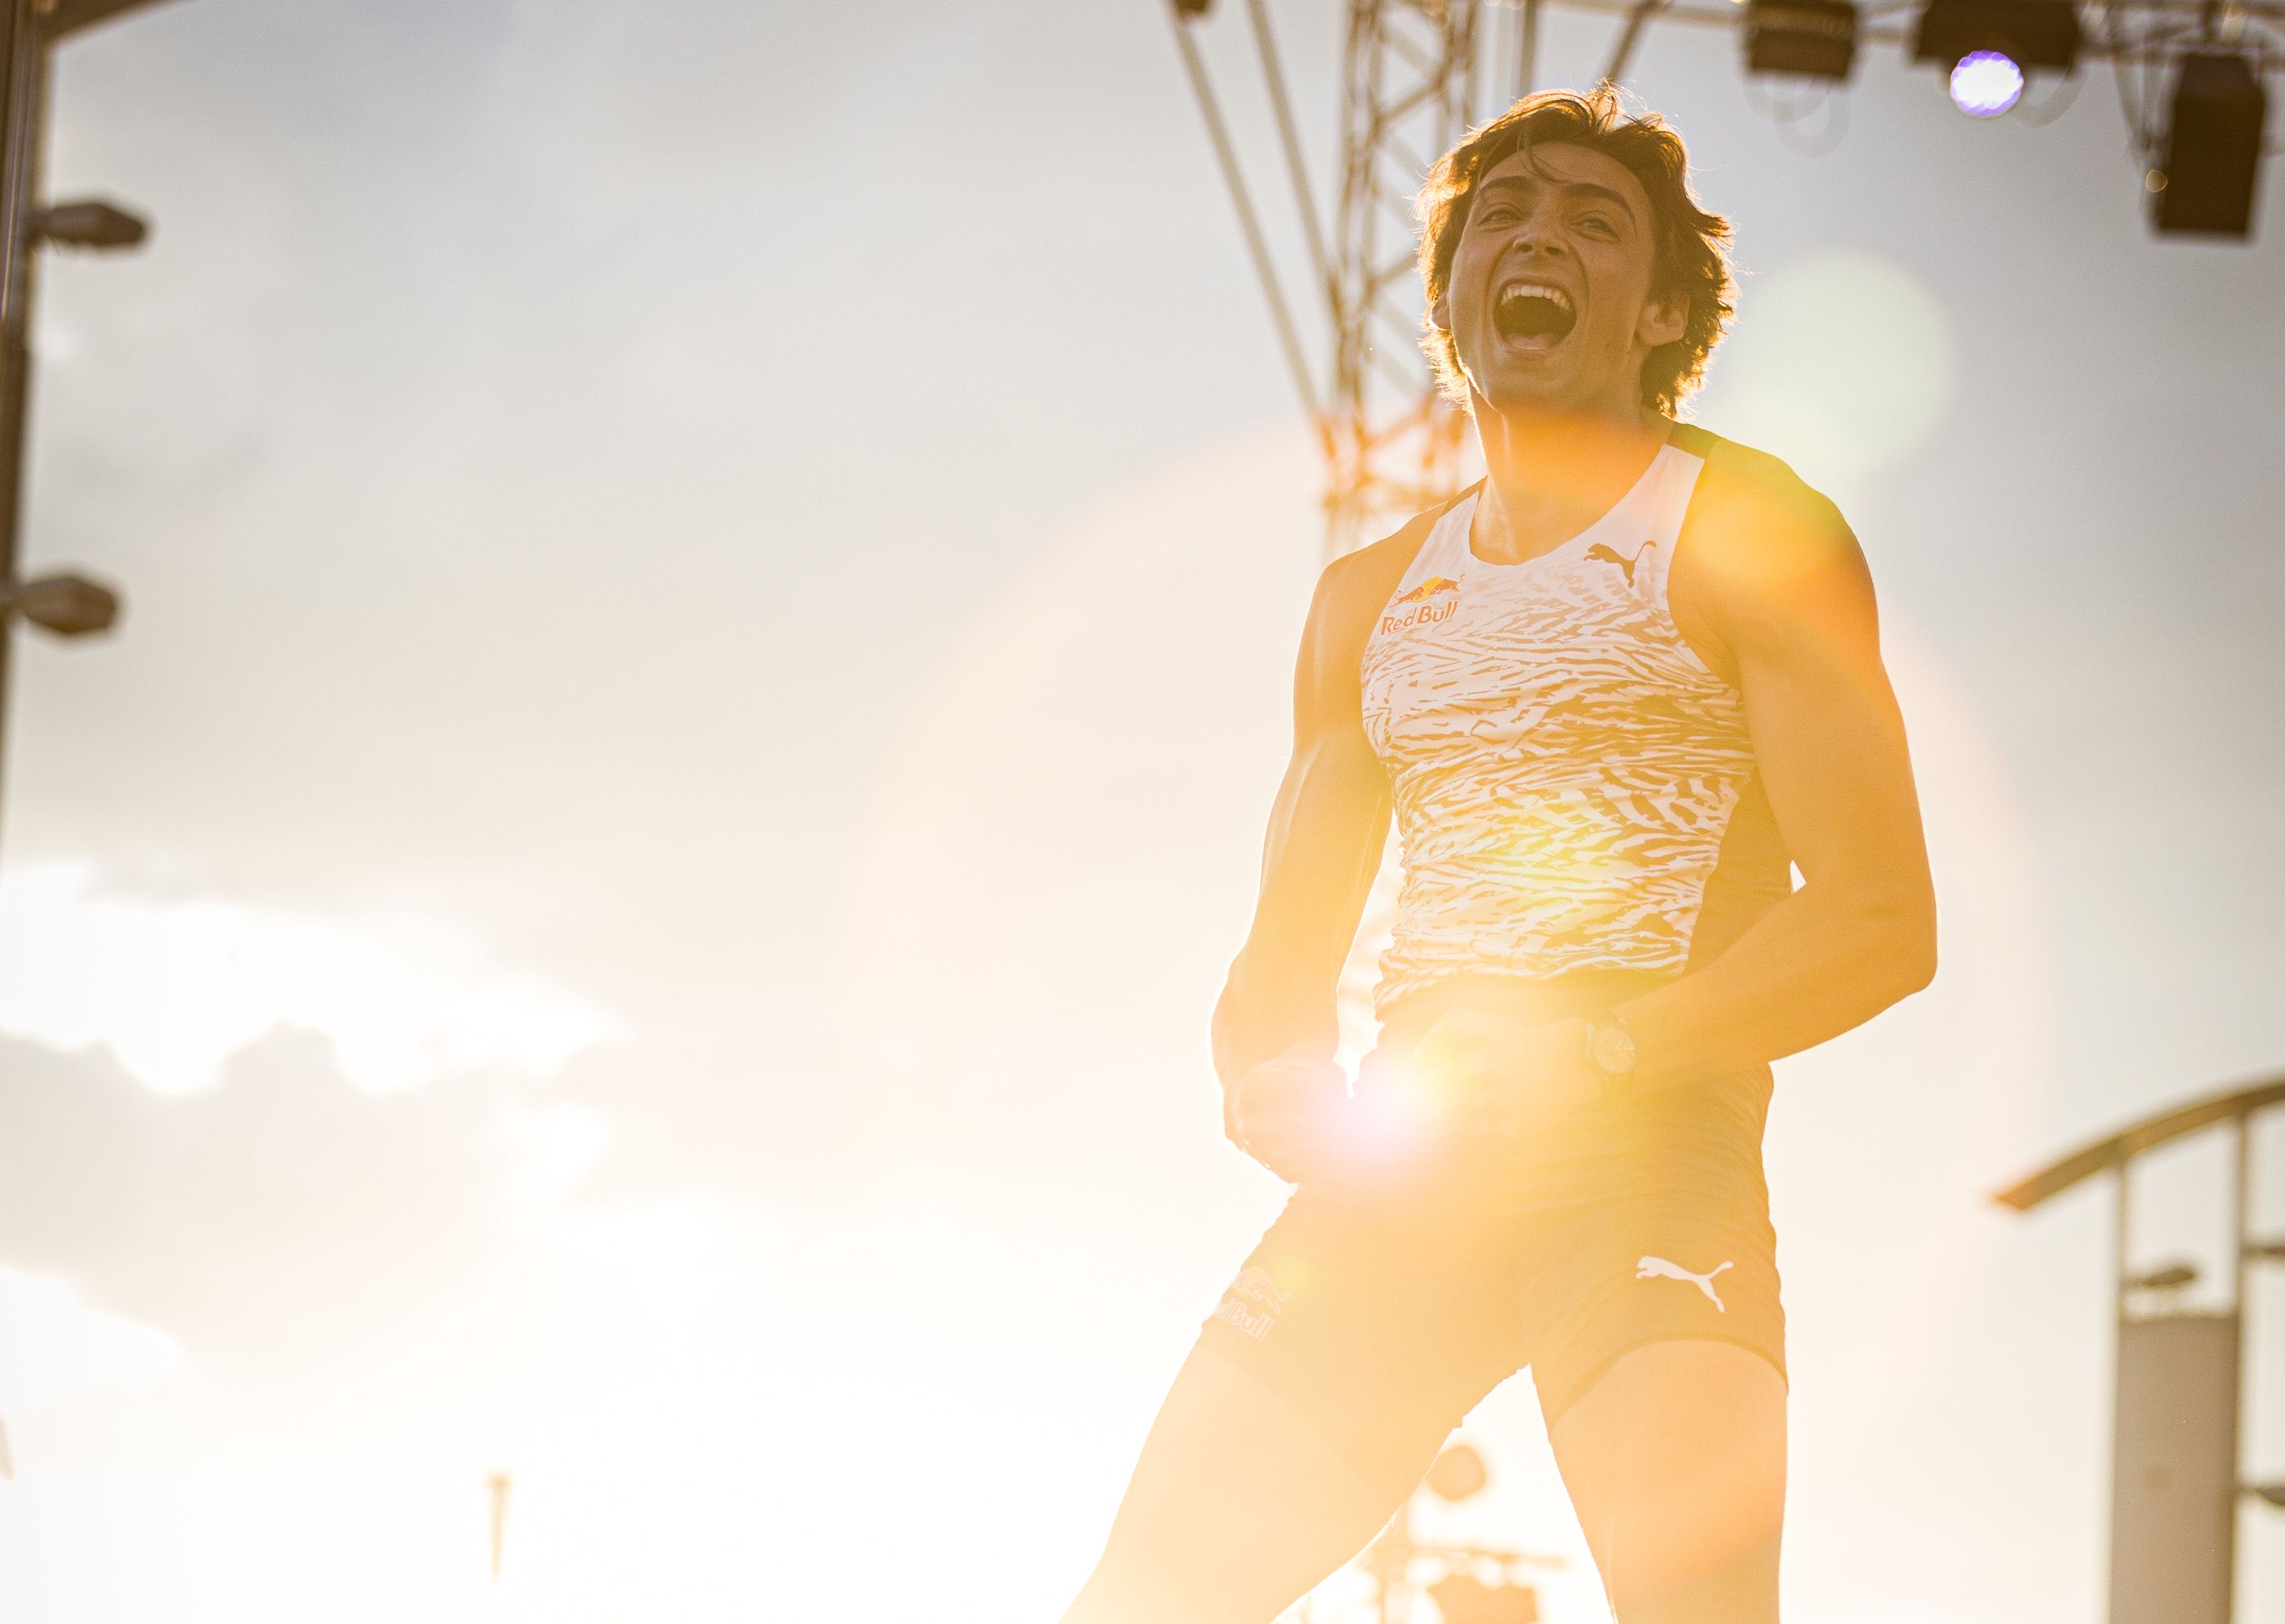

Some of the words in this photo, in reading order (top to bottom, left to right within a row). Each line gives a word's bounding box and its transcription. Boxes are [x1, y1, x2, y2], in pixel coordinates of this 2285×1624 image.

[1381, 607, 1417, 635] Red
[1417, 601, 1458, 623] Bull
[1227, 1302, 1275, 1341] Bull
